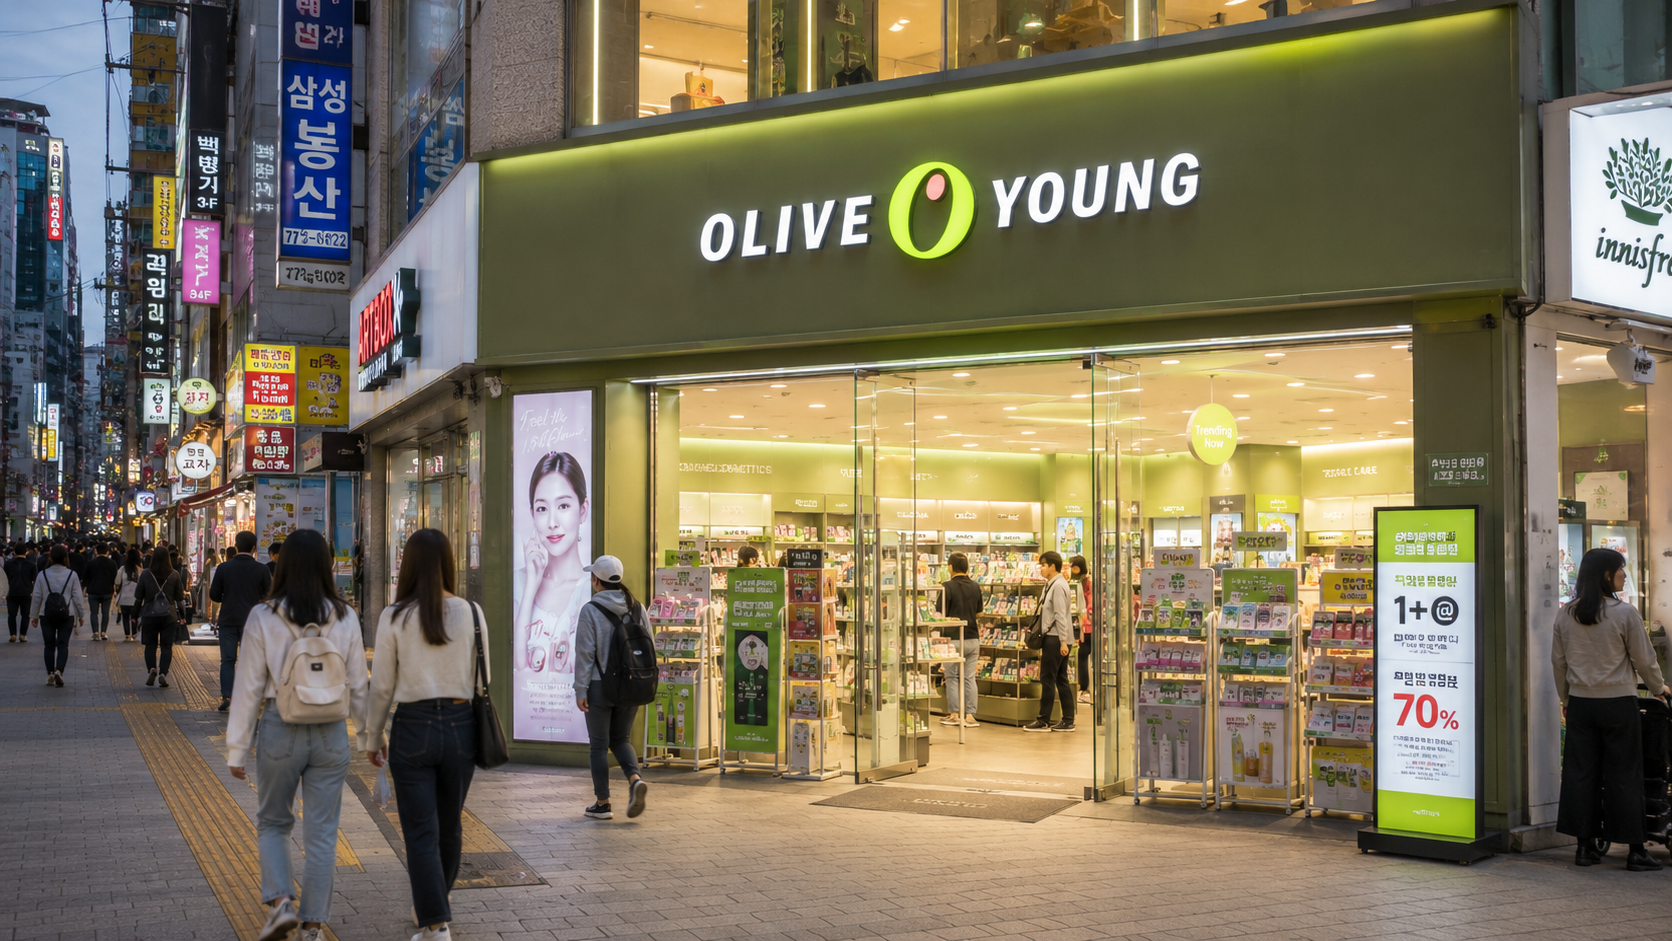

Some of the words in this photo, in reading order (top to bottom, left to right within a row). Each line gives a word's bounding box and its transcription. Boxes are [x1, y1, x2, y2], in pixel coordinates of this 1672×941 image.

[287, 75, 346, 114] 삼성
[700, 194, 875, 262] OLIVE
[992, 152, 1200, 229] YOUNG
[358, 281, 394, 367] ARTBOX
[1195, 424, 1233, 439] Trending
[1204, 437, 1224, 448] Now
[1393, 693, 1459, 730] 70%
